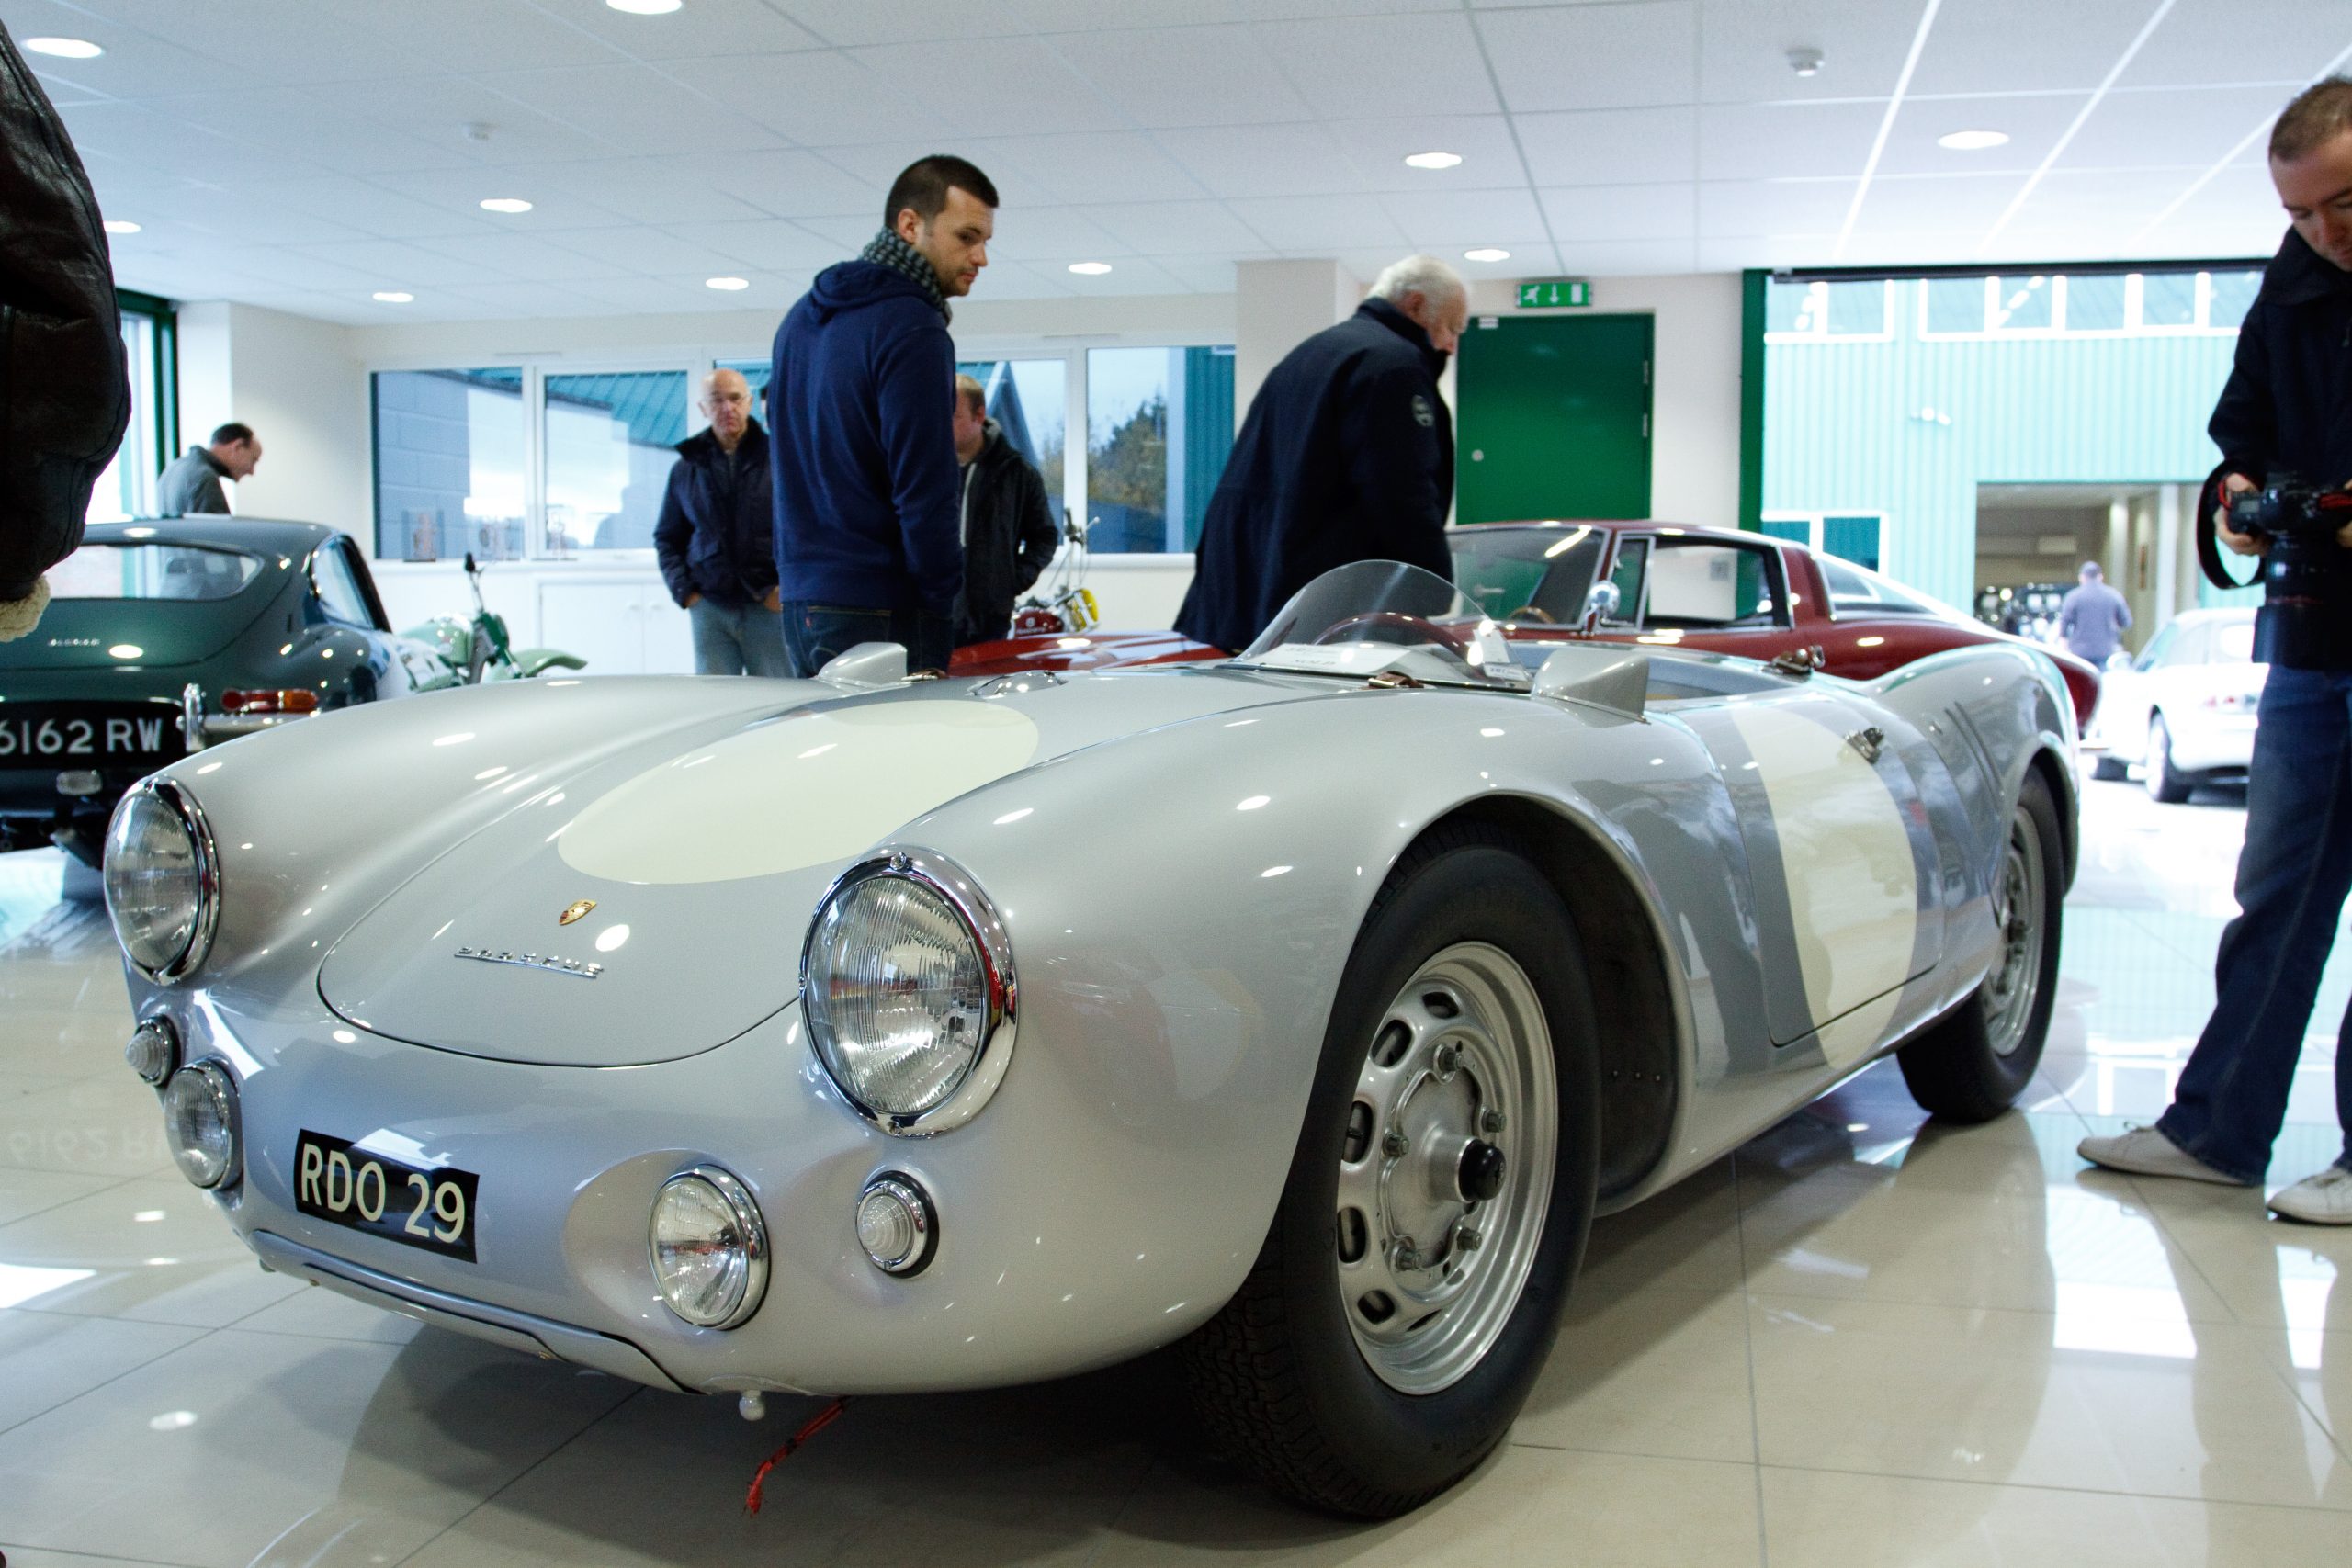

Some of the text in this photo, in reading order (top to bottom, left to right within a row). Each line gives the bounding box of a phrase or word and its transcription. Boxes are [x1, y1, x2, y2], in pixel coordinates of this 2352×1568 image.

[0, 717, 163, 755] 6162 RW
[300, 1143, 466, 1243] RDO 29
